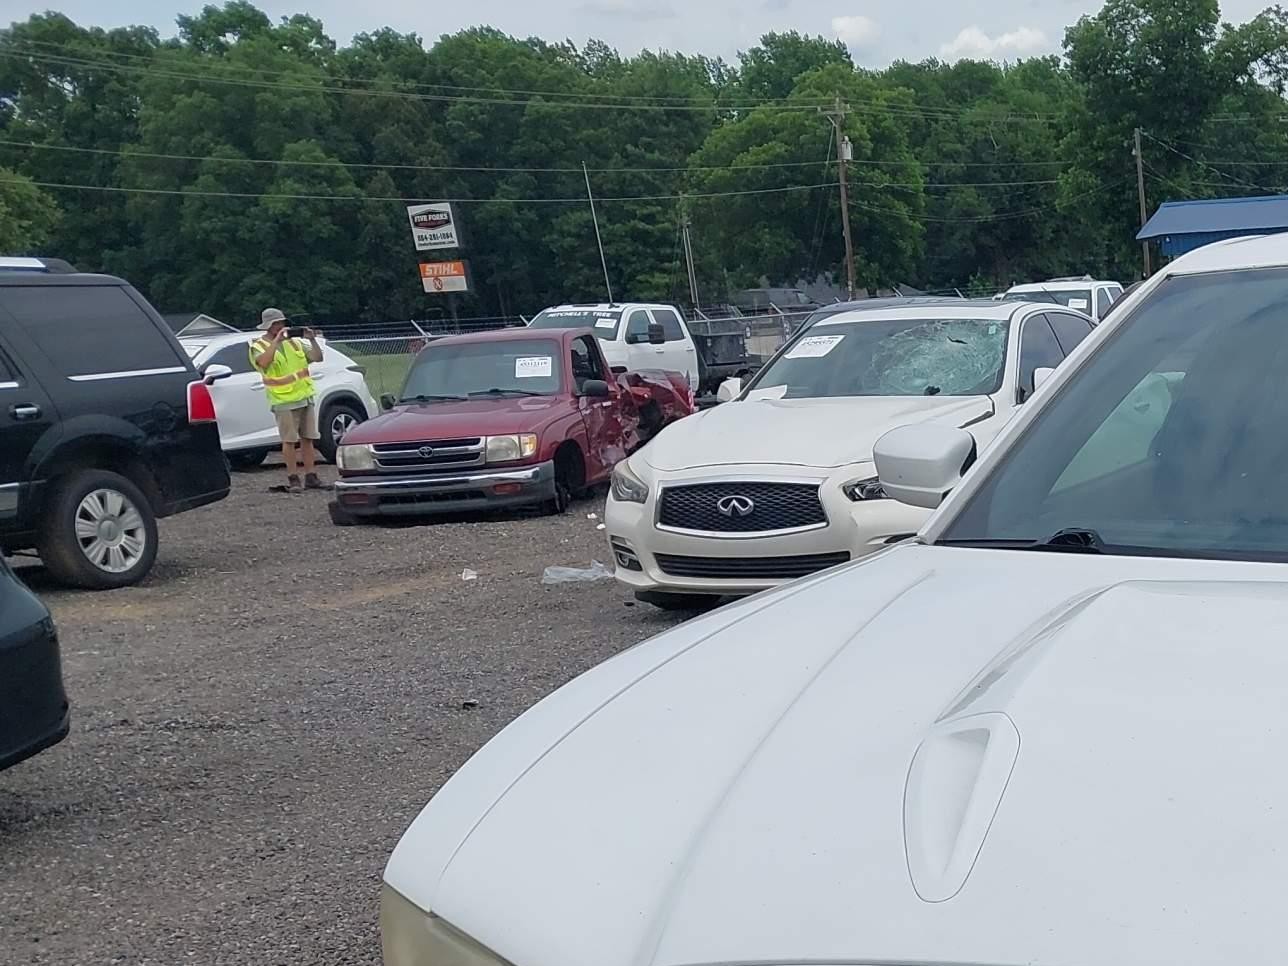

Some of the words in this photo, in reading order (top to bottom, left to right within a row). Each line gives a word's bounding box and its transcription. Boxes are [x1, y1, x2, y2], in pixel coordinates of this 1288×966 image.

[414, 215, 428, 223] FIVE
[428, 213, 448, 222] FORKS
[425, 264, 457, 276] STIHL
